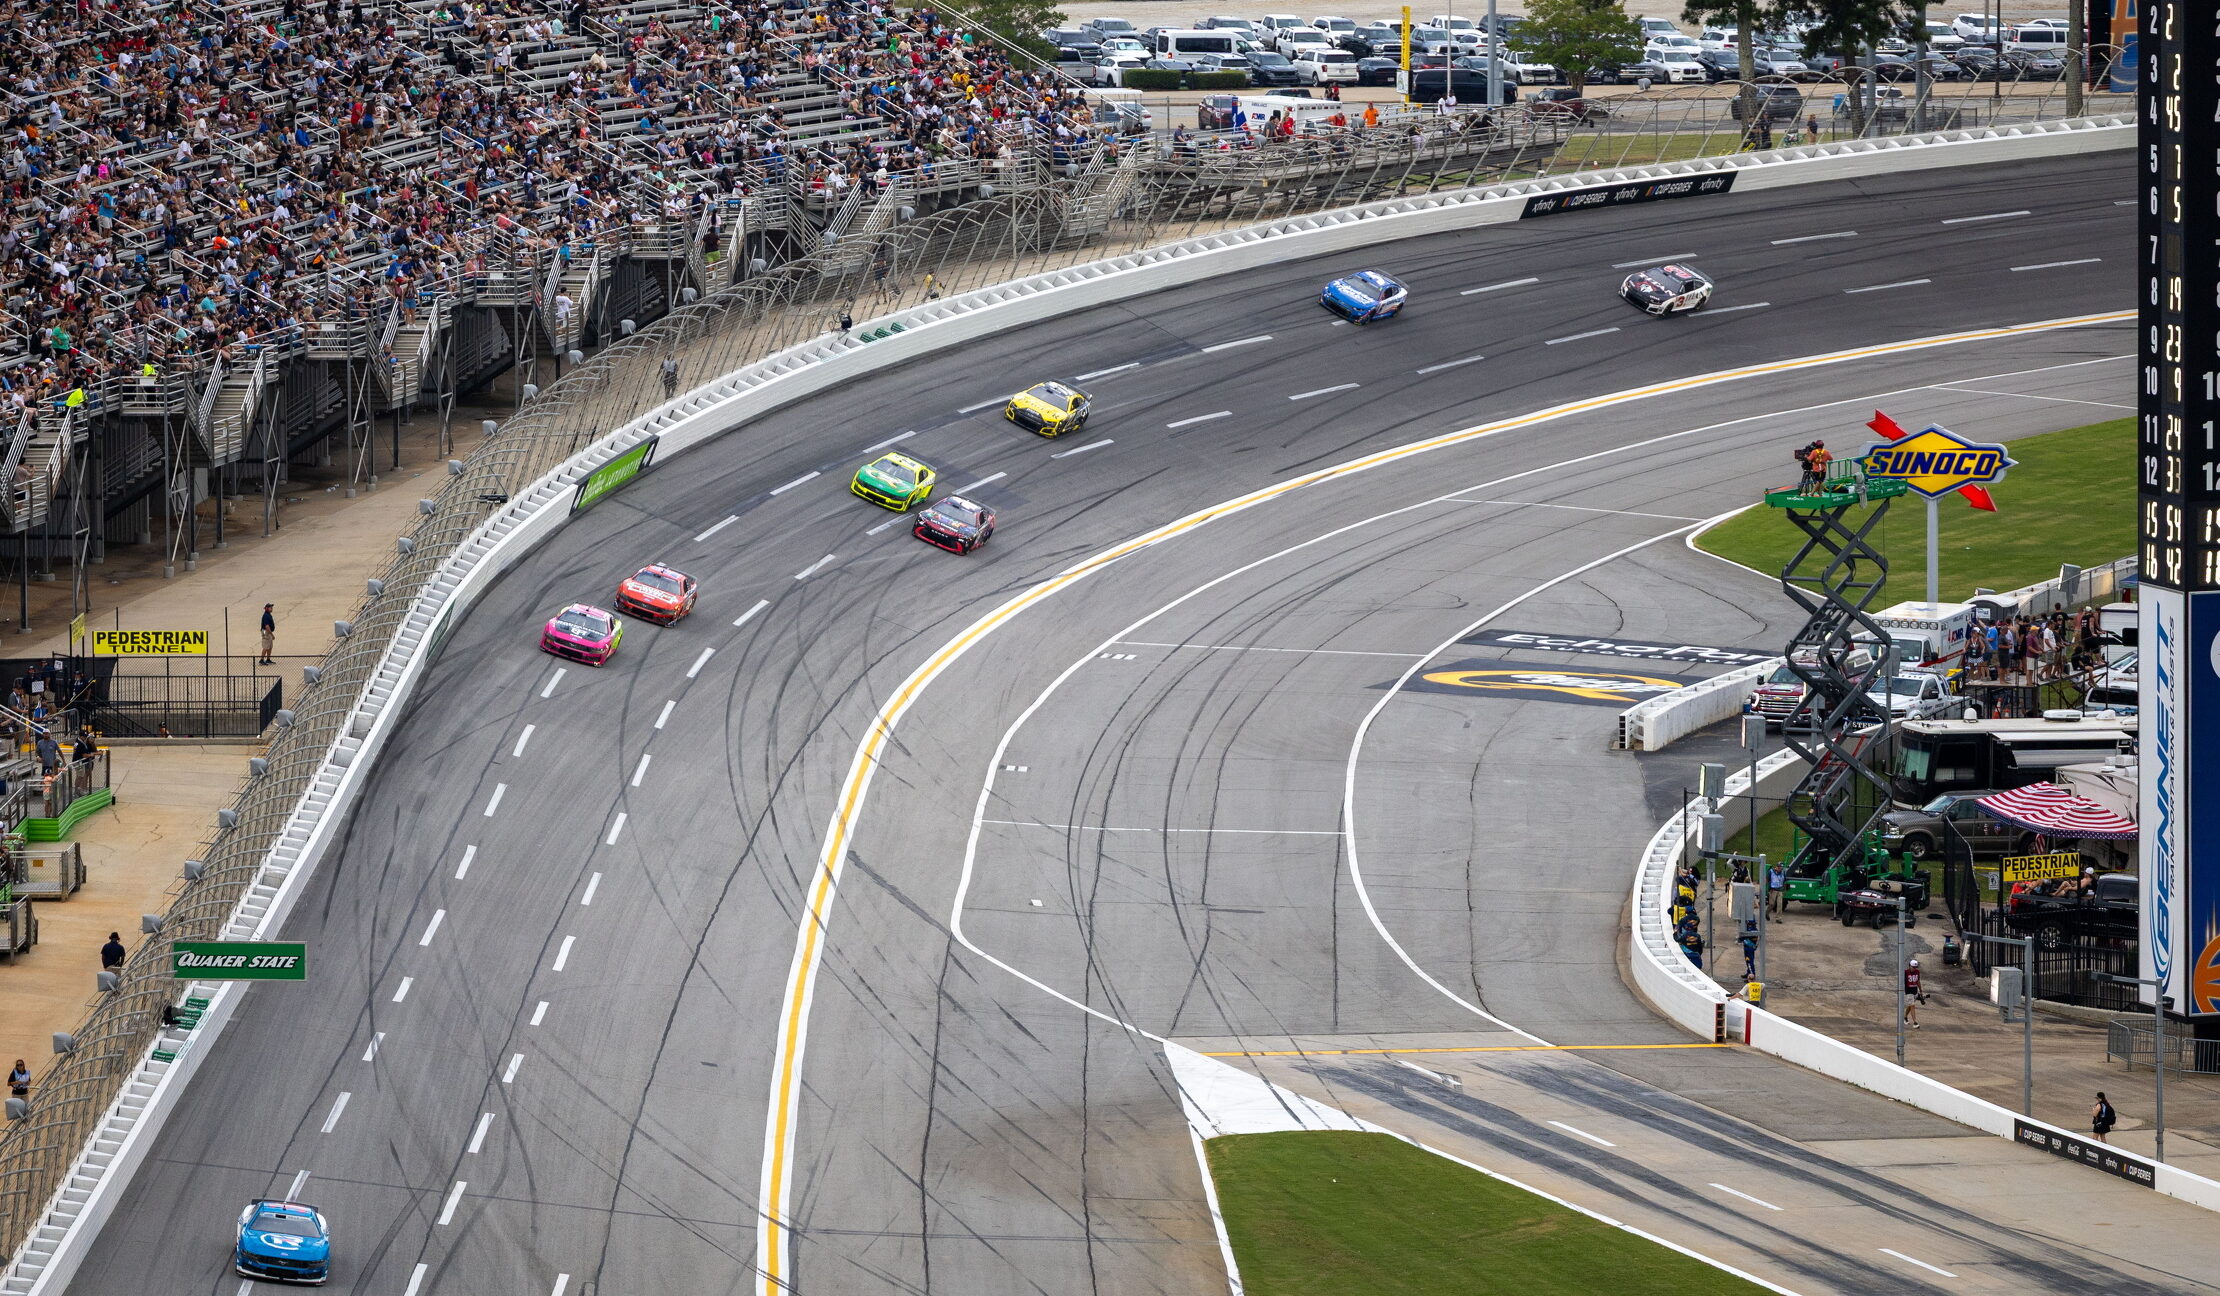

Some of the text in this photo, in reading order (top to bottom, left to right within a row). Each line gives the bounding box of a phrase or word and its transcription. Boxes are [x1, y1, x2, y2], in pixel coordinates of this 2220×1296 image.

[2150, 3, 2174, 40] 2 2
[2150, 53, 2181, 91] 3 2
[2150, 95, 2181, 133] 4 45
[2150, 144, 2158, 173] 5
[1532, 198, 1556, 213] xfinity
[1584, 192, 1608, 204] SERIES
[1614, 187, 1640, 200] xfinity
[1670, 181, 1694, 194] SERIES
[1699, 178, 1724, 191] xfinity
[2150, 186, 2181, 223] 6 5
[2150, 235, 2158, 264] 7
[2151, 276, 2182, 312] 8 19
[2150, 324, 2182, 363] 9 23
[2145, 366, 2182, 402] 10 9
[2144, 414, 2182, 451] 11 24
[1870, 451, 1998, 476] SUNOCO
[2144, 455, 2182, 494] 12 33
[2146, 501, 2182, 542] 15 54
[2146, 543, 2182, 585] 16 42
[96, 632, 204, 644] PEDESTRIAN
[108, 645, 192, 653] TUNNEL
[1534, 646, 1740, 664] AUTOMOTIVE
[2156, 600, 2169, 955] BENNETT
[2004, 854, 2079, 872] PEDESTRIAN
[2013, 868, 2070, 880] TUNNEL
[177, 952, 300, 968] QUAKER STATE
[2032, 1132, 2046, 1144] SERIES
[2137, 1168, 2152, 1182] SERIES
